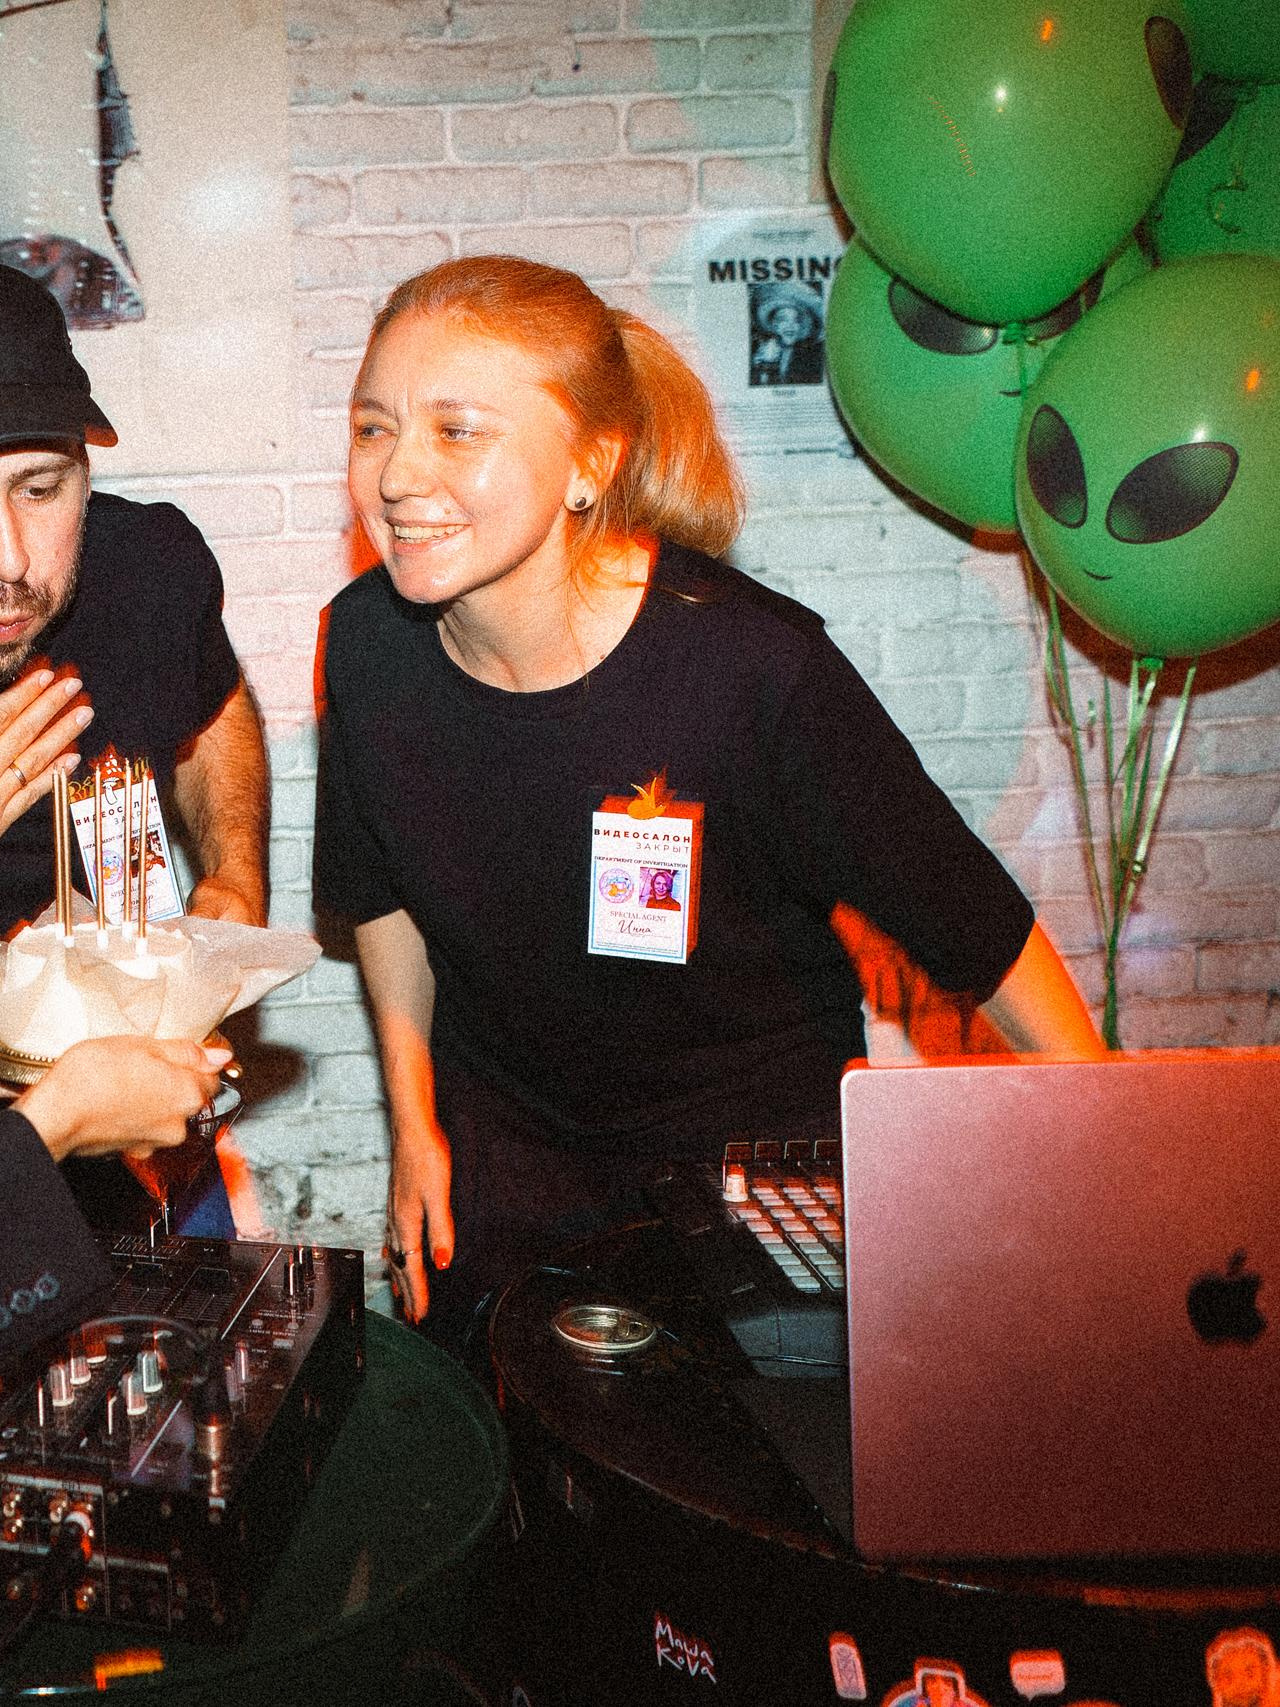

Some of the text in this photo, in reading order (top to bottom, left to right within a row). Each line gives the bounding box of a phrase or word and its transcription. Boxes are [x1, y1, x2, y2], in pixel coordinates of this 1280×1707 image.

[594, 829, 690, 843] ВИДЕОСАЛОН
[636, 842, 689, 854] ЗАКРЫТ
[594, 856, 632, 864] DEPARTMENT
[610, 911, 667, 922] SPECIAL AGENT
